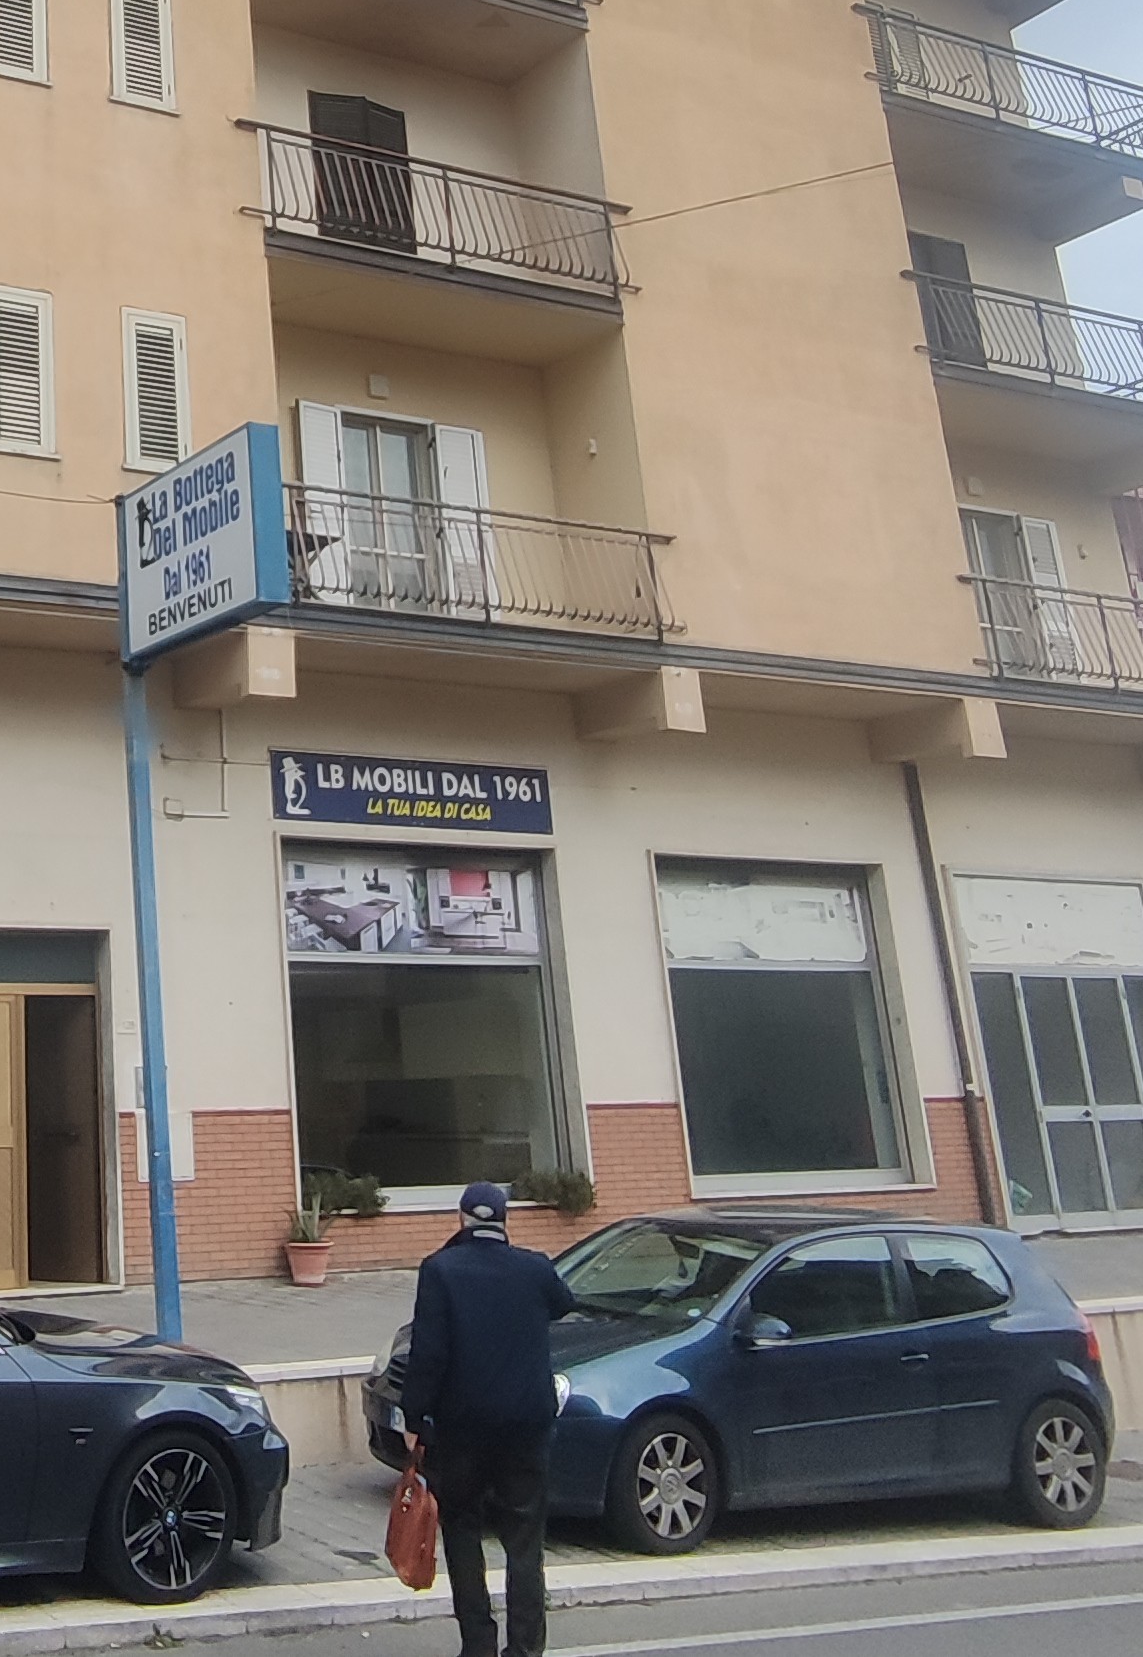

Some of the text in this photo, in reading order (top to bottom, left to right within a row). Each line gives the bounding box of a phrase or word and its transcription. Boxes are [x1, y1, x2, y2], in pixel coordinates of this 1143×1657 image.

[151, 451, 236, 524] La Bottega
[154, 488, 241, 560] Del Mobile
[164, 544, 212, 601] Dal 1961
[148, 577, 233, 636] BENVENUTI
[316, 763, 542, 803] LB MOBILI DAL 1961
[366, 797, 492, 821] LA TUA IDEA DI CASA
